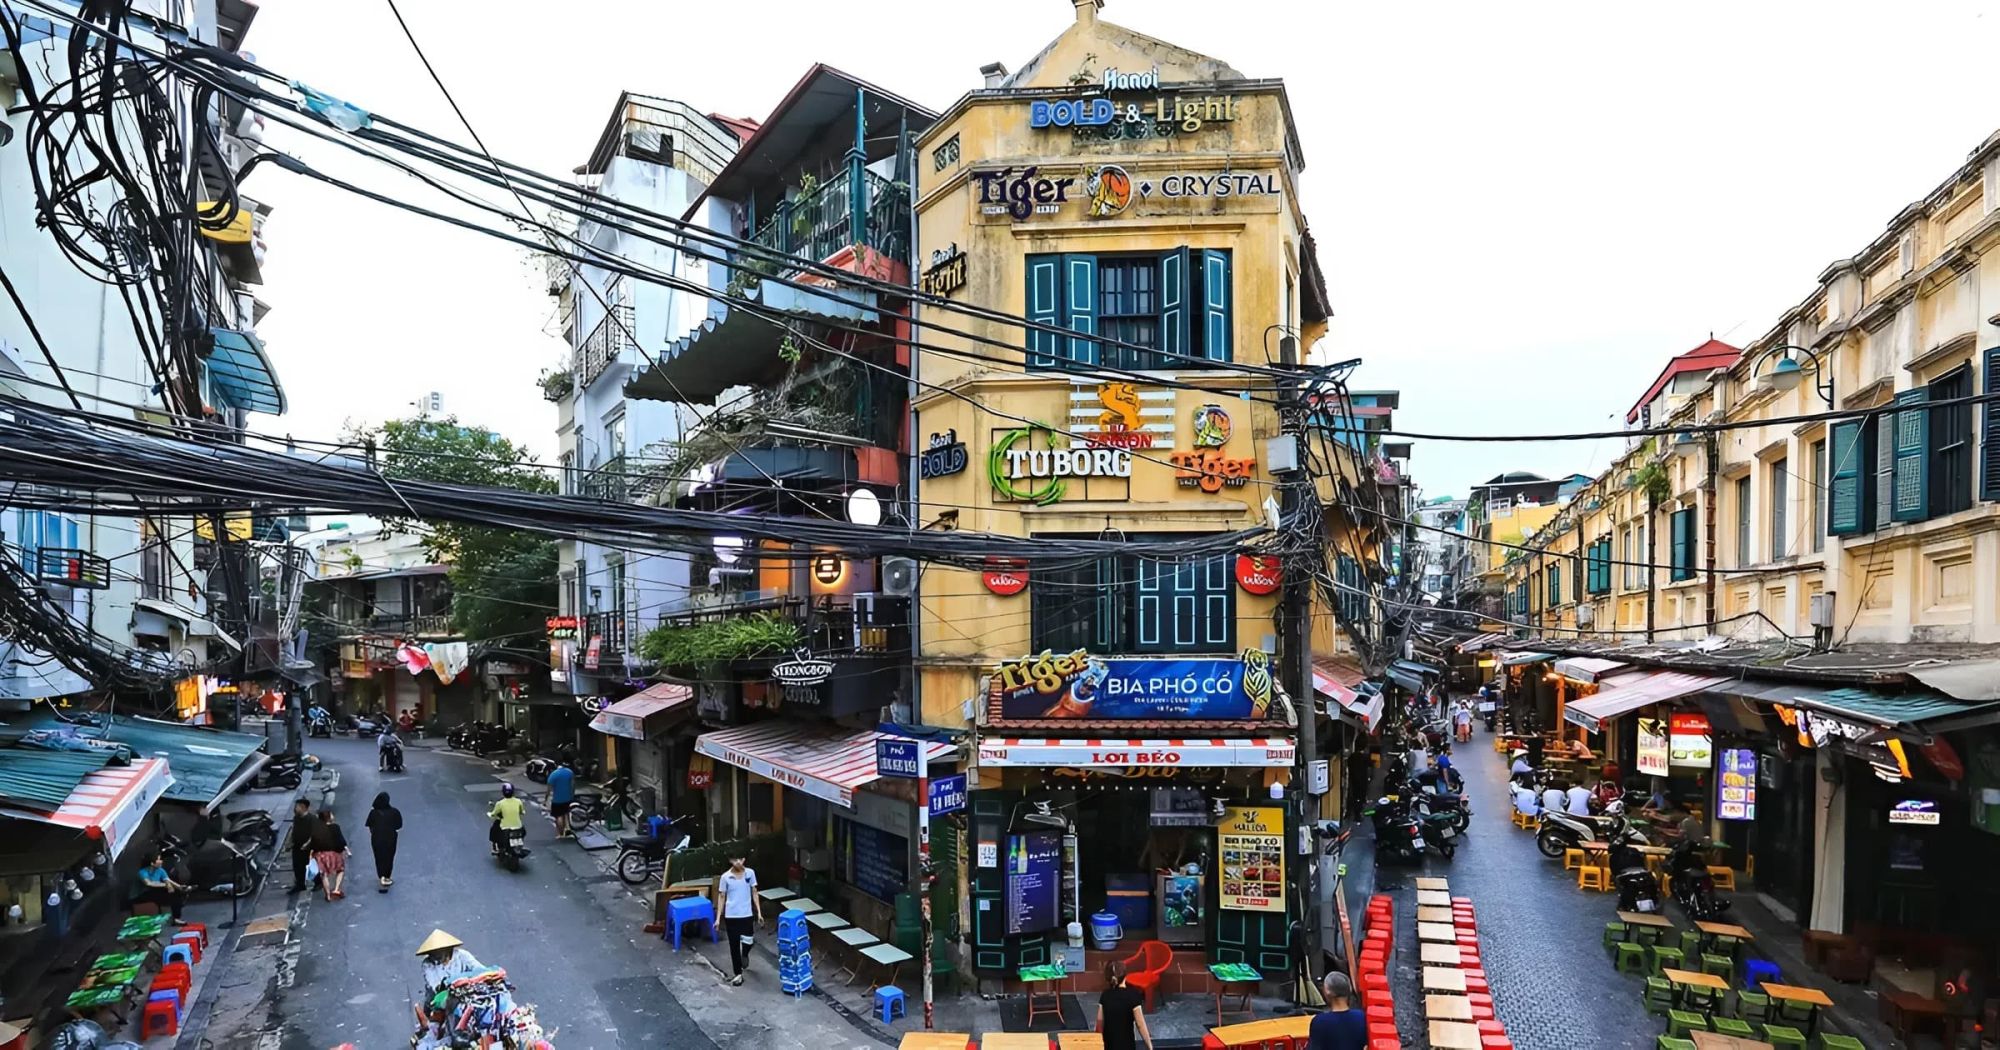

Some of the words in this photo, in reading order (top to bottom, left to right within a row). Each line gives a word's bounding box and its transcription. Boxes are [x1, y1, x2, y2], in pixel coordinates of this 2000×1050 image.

[1103, 67, 1159, 91] Hanoi
[1030, 99, 1115, 128] BOLD
[1124, 104, 1145, 123] &
[1156, 95, 1234, 132] Light
[971, 166, 1075, 219] Tiger
[1160, 174, 1281, 198] CRYSTAL
[1006, 449, 1131, 478] TUBORG
[1168, 449, 1257, 492] Tiger
[991, 649, 1090, 694] Tiger
[1108, 678, 1143, 694] BIA
[1149, 673, 1197, 694] PHỐ
